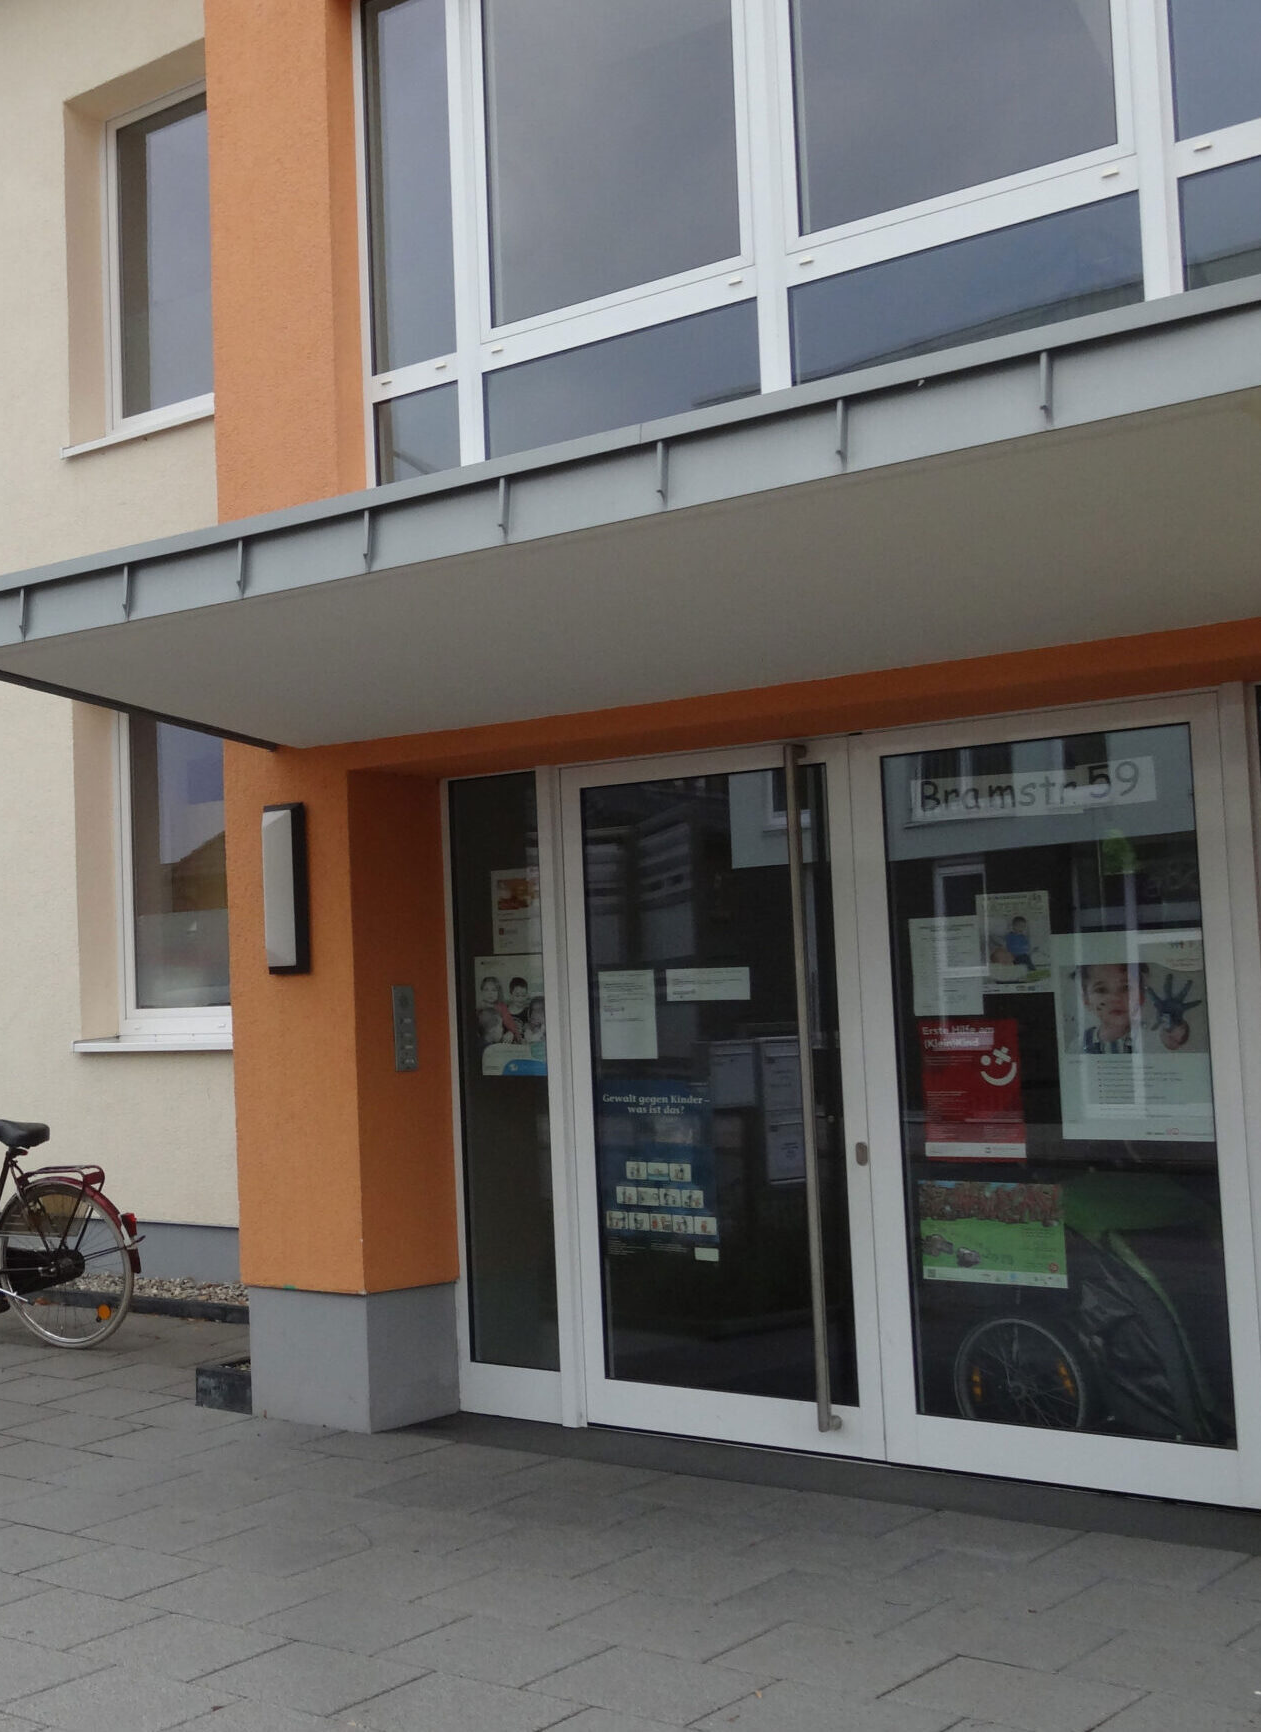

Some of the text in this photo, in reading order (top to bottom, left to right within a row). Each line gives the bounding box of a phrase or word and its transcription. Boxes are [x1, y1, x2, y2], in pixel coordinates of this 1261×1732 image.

[1088, 760, 1140, 800] 59
[602, 1094, 637, 1104] Gewalt
[639, 1096, 669, 1106] gegen
[627, 1105, 648, 1114] was
[649, 1105, 661, 1114] ist
